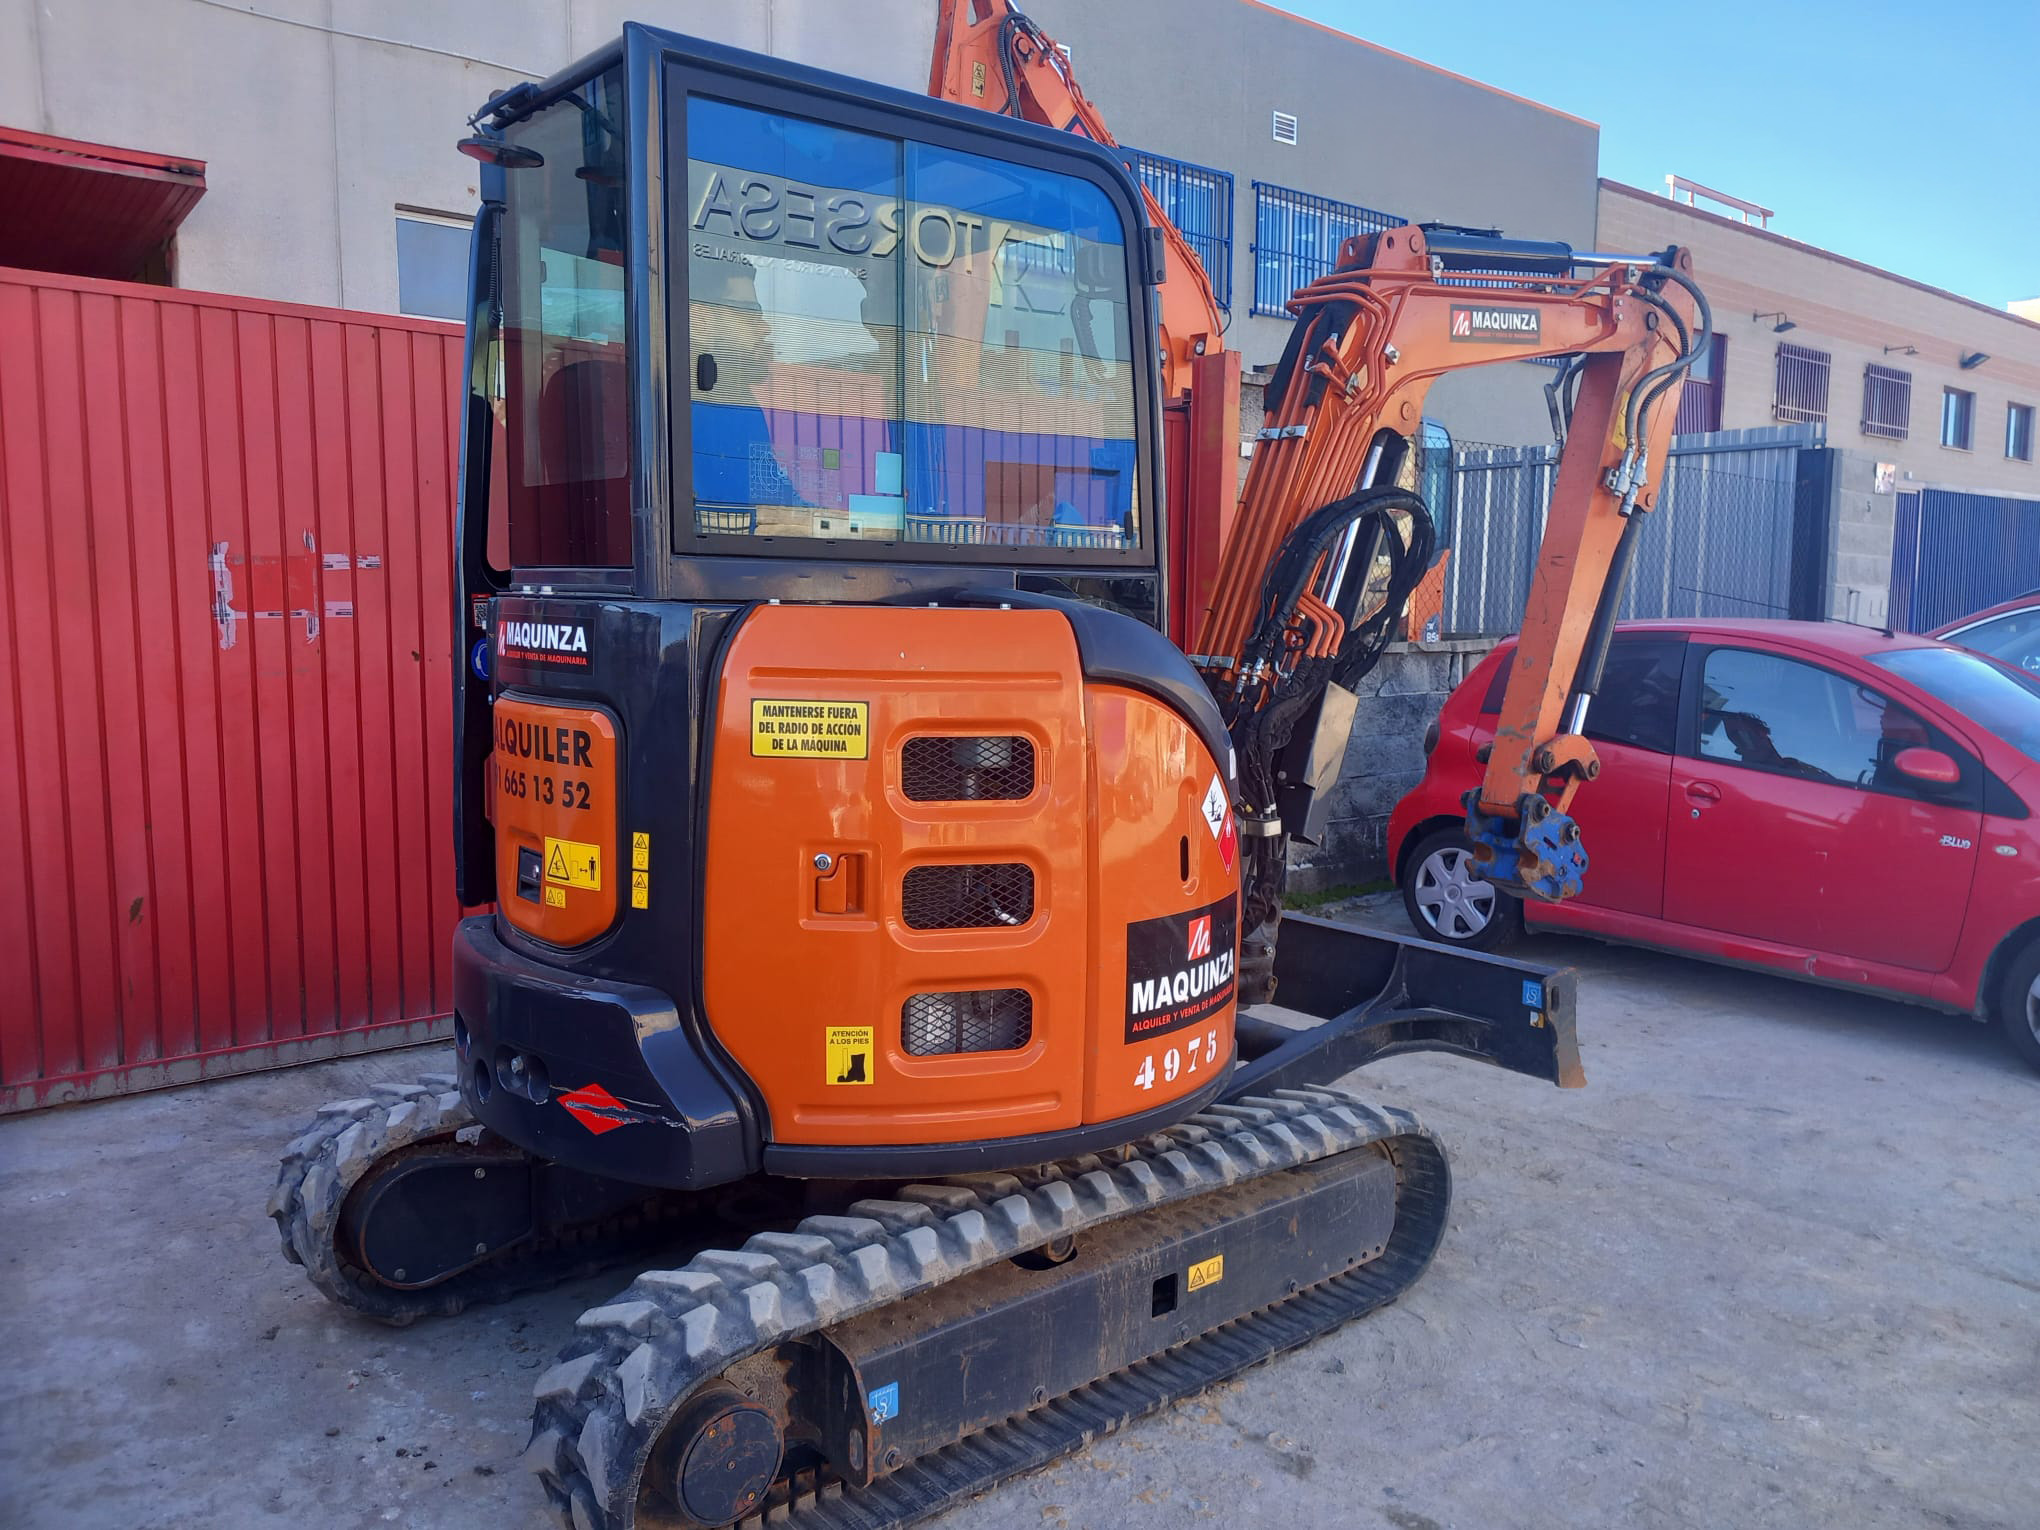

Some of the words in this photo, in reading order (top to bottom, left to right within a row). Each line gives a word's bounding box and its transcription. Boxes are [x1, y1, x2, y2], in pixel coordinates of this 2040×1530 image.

[1472, 311, 1538, 331] MAQUINZA
[506, 621, 588, 653] MAQUINZA
[547, 655, 588, 666] MAQUINARIA
[762, 705, 825, 718] MANTENERSE
[827, 707, 858, 720] FUERA
[758, 721, 775, 734] DEL
[778, 722, 808, 735] RADIO
[811, 723, 823, 735] DE
[826, 720, 861, 736] ACCIÓN
[772, 738, 784, 750] DE
[787, 739, 798, 751] LA
[801, 736, 847, 752] MÁQUINA
[504, 768, 527, 799] 665
[534, 775, 554, 805] 13
[562, 780, 591, 810] 52
[1132, 948, 1234, 1015] MAQUINZA
[1132, 1014, 1171, 1033] ALQUILER
[1173, 1011, 1178, 1022] Y
[1180, 1004, 1200, 1019] VENTA
[1201, 1001, 1209, 1011] DE
[831, 1029, 869, 1037] ATENCIÓN
